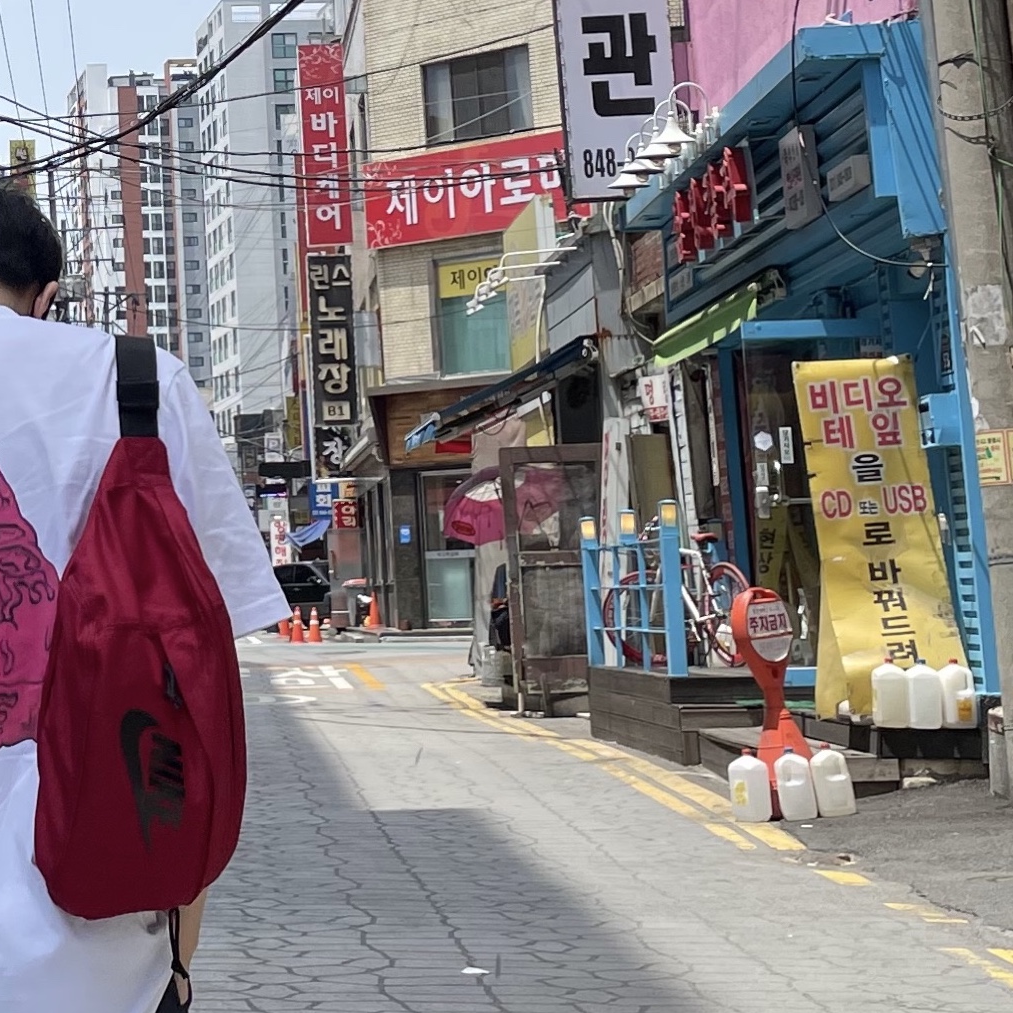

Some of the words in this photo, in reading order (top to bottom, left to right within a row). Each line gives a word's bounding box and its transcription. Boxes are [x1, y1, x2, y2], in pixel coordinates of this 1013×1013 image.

[580, 11, 658, 118] 관
[304, 86, 339, 105] 제이
[309, 111, 342, 230] 바디케어
[309, 263, 351, 290] 린스
[317, 295, 352, 395] 노래장
[327, 404, 345, 417] B1
[808, 376, 908, 415] 비디오
[822, 412, 902, 449] 테잎
[851, 453, 884, 483] 을
[820, 490, 853, 519] CD
[858, 500, 879, 515] 또는
[881, 484, 928, 514] USB
[862, 521, 896, 547] 로
[867, 558, 919, 670] 바꿔드려
